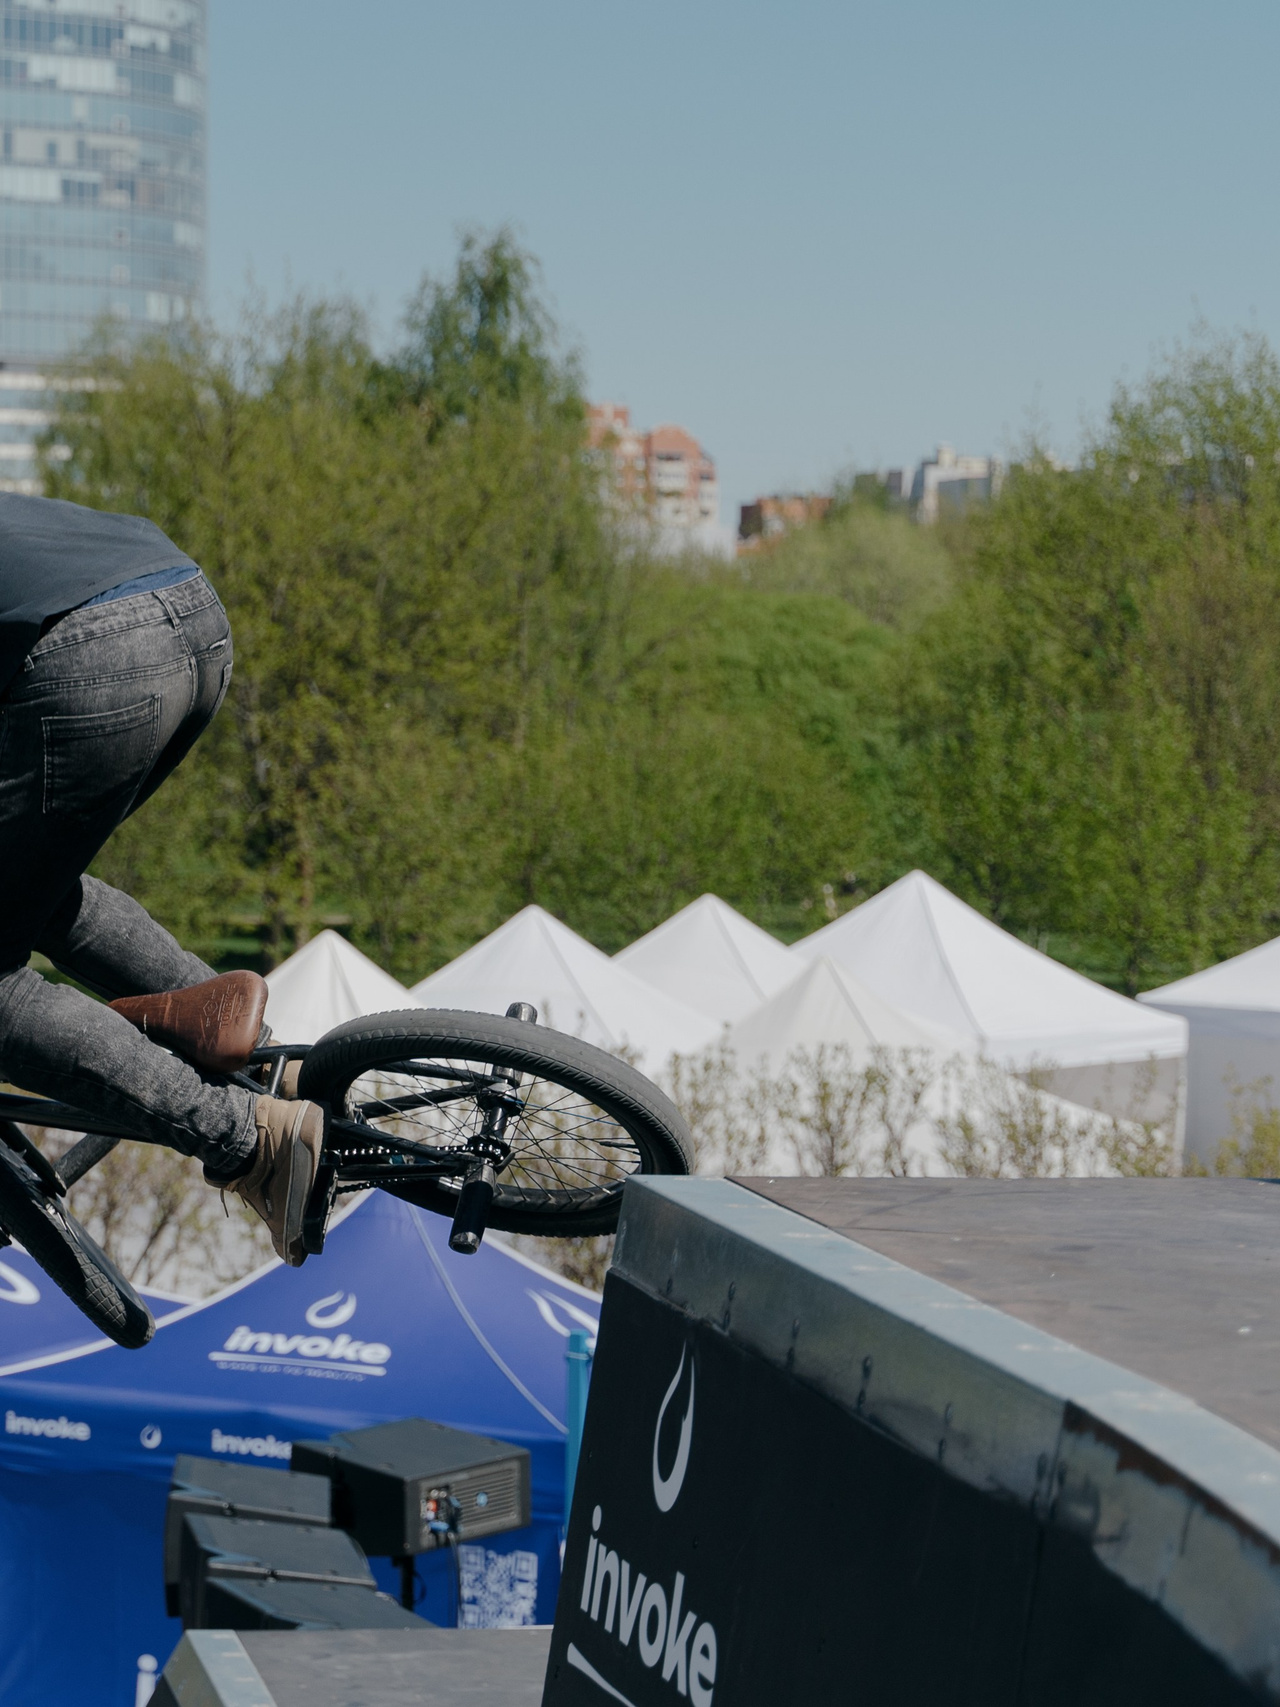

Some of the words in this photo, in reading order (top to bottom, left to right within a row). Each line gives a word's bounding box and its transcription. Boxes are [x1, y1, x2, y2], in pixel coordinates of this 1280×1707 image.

[223, 1325, 393, 1365] invoke
[5, 1409, 91, 1441] invoke
[580, 1505, 717, 1707] invoke
